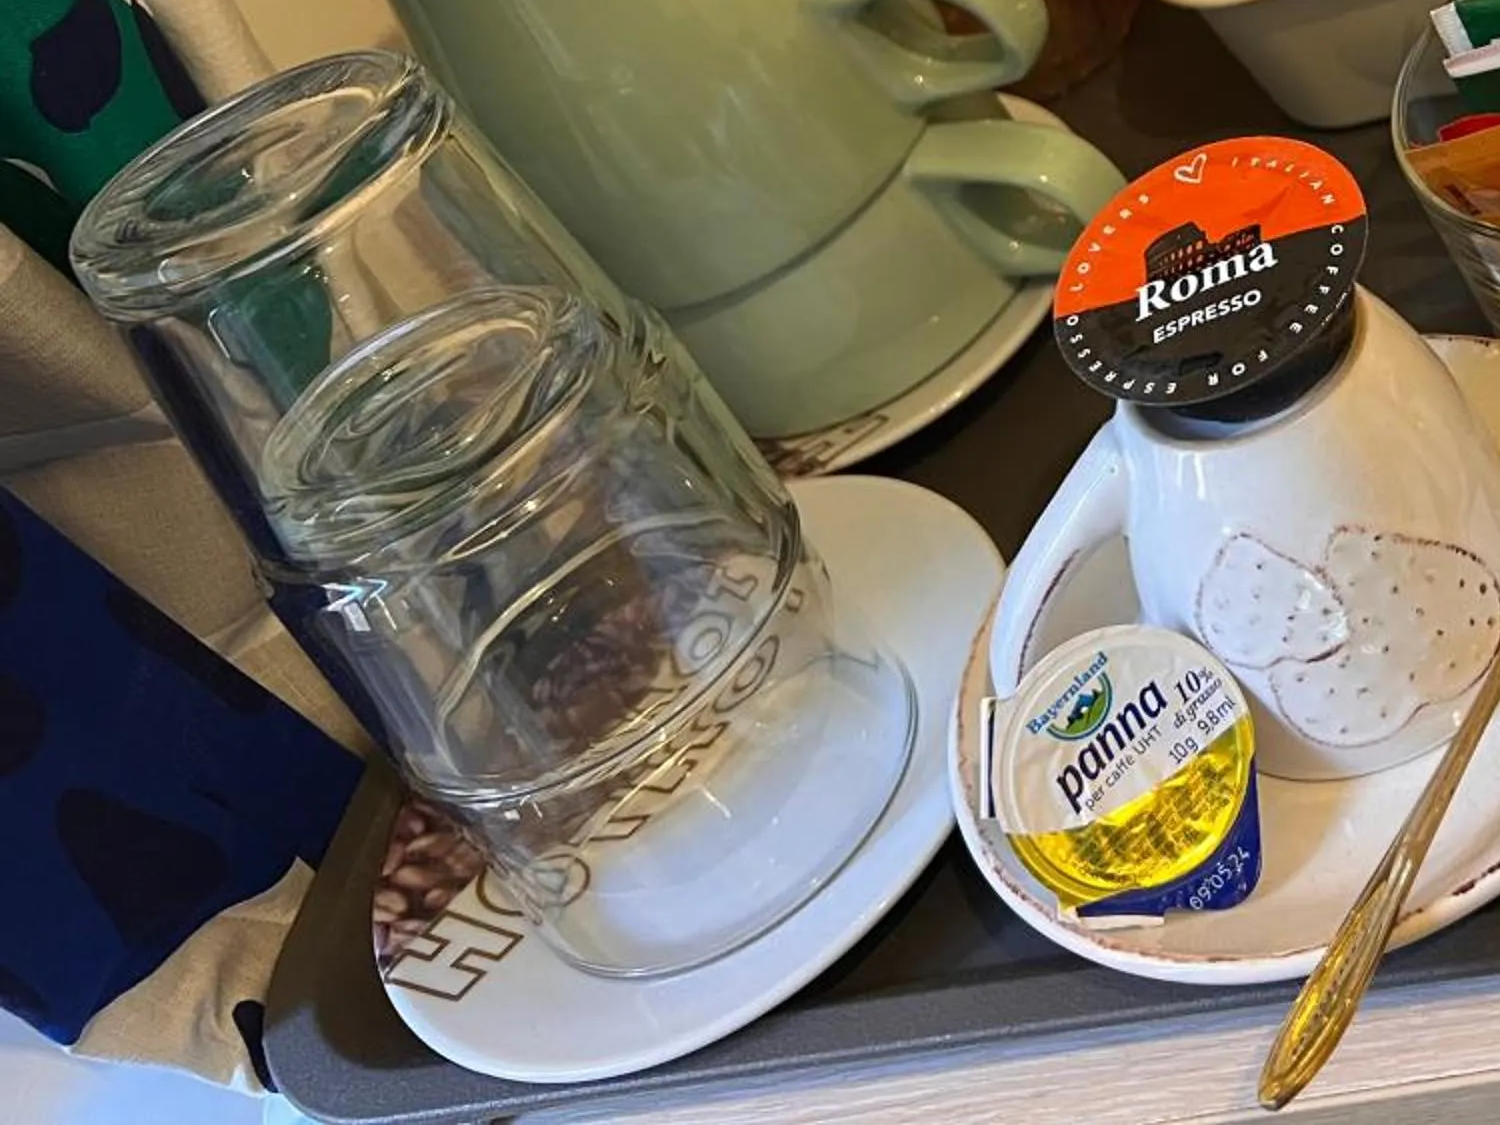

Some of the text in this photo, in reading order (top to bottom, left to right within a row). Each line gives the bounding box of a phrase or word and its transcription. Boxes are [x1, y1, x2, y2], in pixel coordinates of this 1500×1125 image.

[1066, 156, 1344, 394] ITALIAN COFFEE FOR ESPRESSO LOVERS
[1135, 241, 1279, 322] Roma
[1152, 288, 1262, 344] ESPRESSO
[1025, 650, 1109, 736] Bayernland
[1174, 666, 1214, 704] 10%
[1056, 680, 1168, 815] panna
[1085, 784, 1105, 811] per
[1132, 725, 1162, 756] UHT
[1168, 736, 1198, 765] 10g
